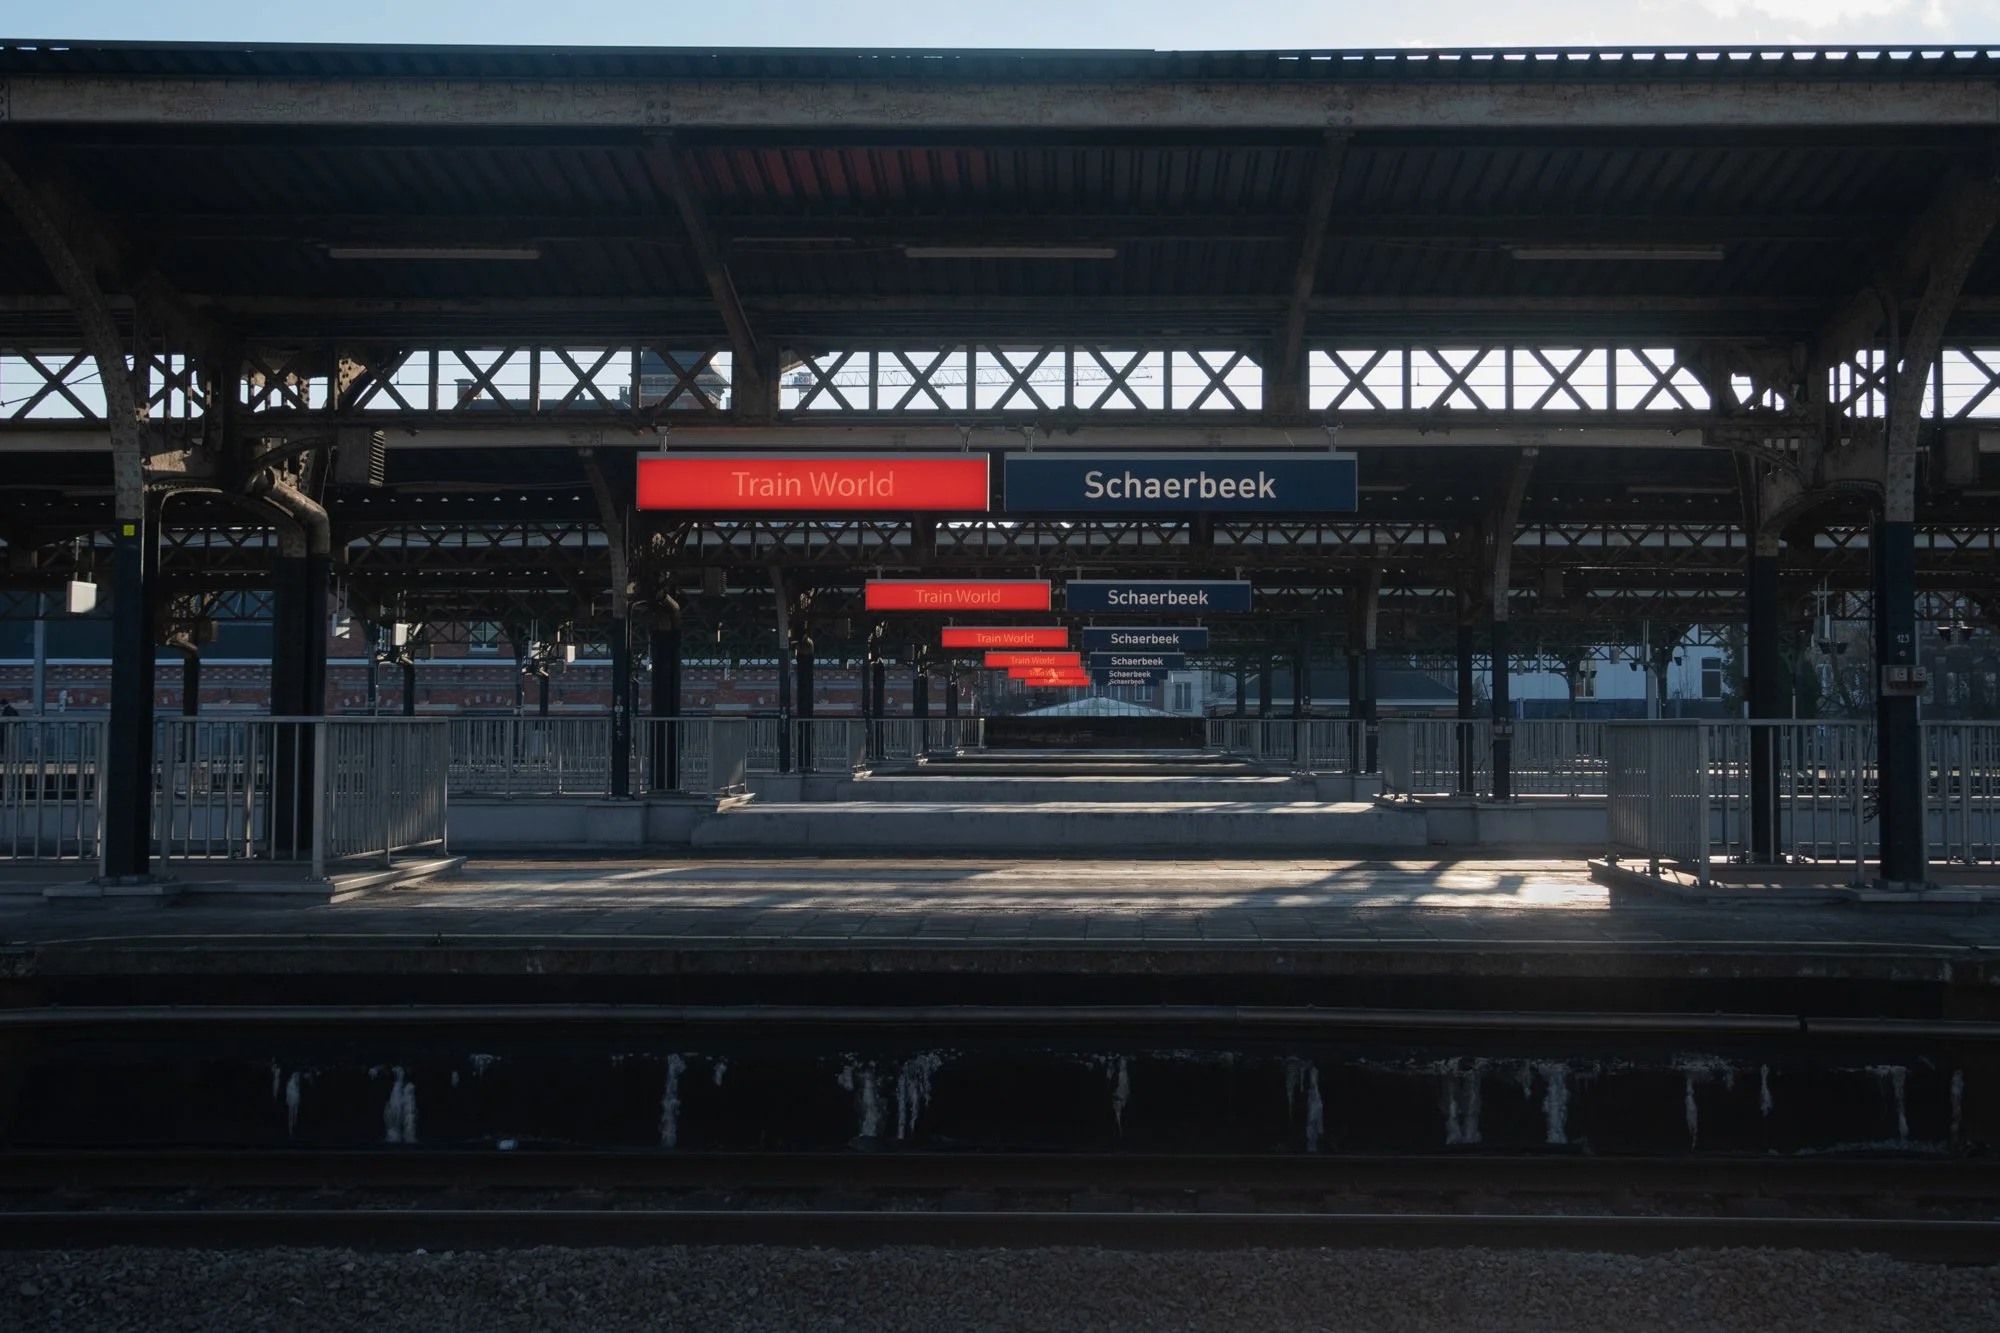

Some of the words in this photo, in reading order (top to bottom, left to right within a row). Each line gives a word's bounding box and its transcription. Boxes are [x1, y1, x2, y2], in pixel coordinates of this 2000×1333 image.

[731, 470, 803, 498] Train
[809, 470, 895, 498] World
[1084, 470, 1277, 500] Schaerbeek
[915, 589, 954, 605] Train
[956, 589, 1001, 605] World
[1108, 589, 1209, 605] Schaerbeek
[976, 633, 1001, 644] Train
[1004, 632, 1035, 644] World
[1111, 632, 1180, 645] Schaerbeek
[1010, 656, 1030, 665] Train
[1031, 656, 1055, 665] World
[1111, 656, 1164, 666] Schaerbeek
[1109, 670, 1151, 678] Schaerbeek
